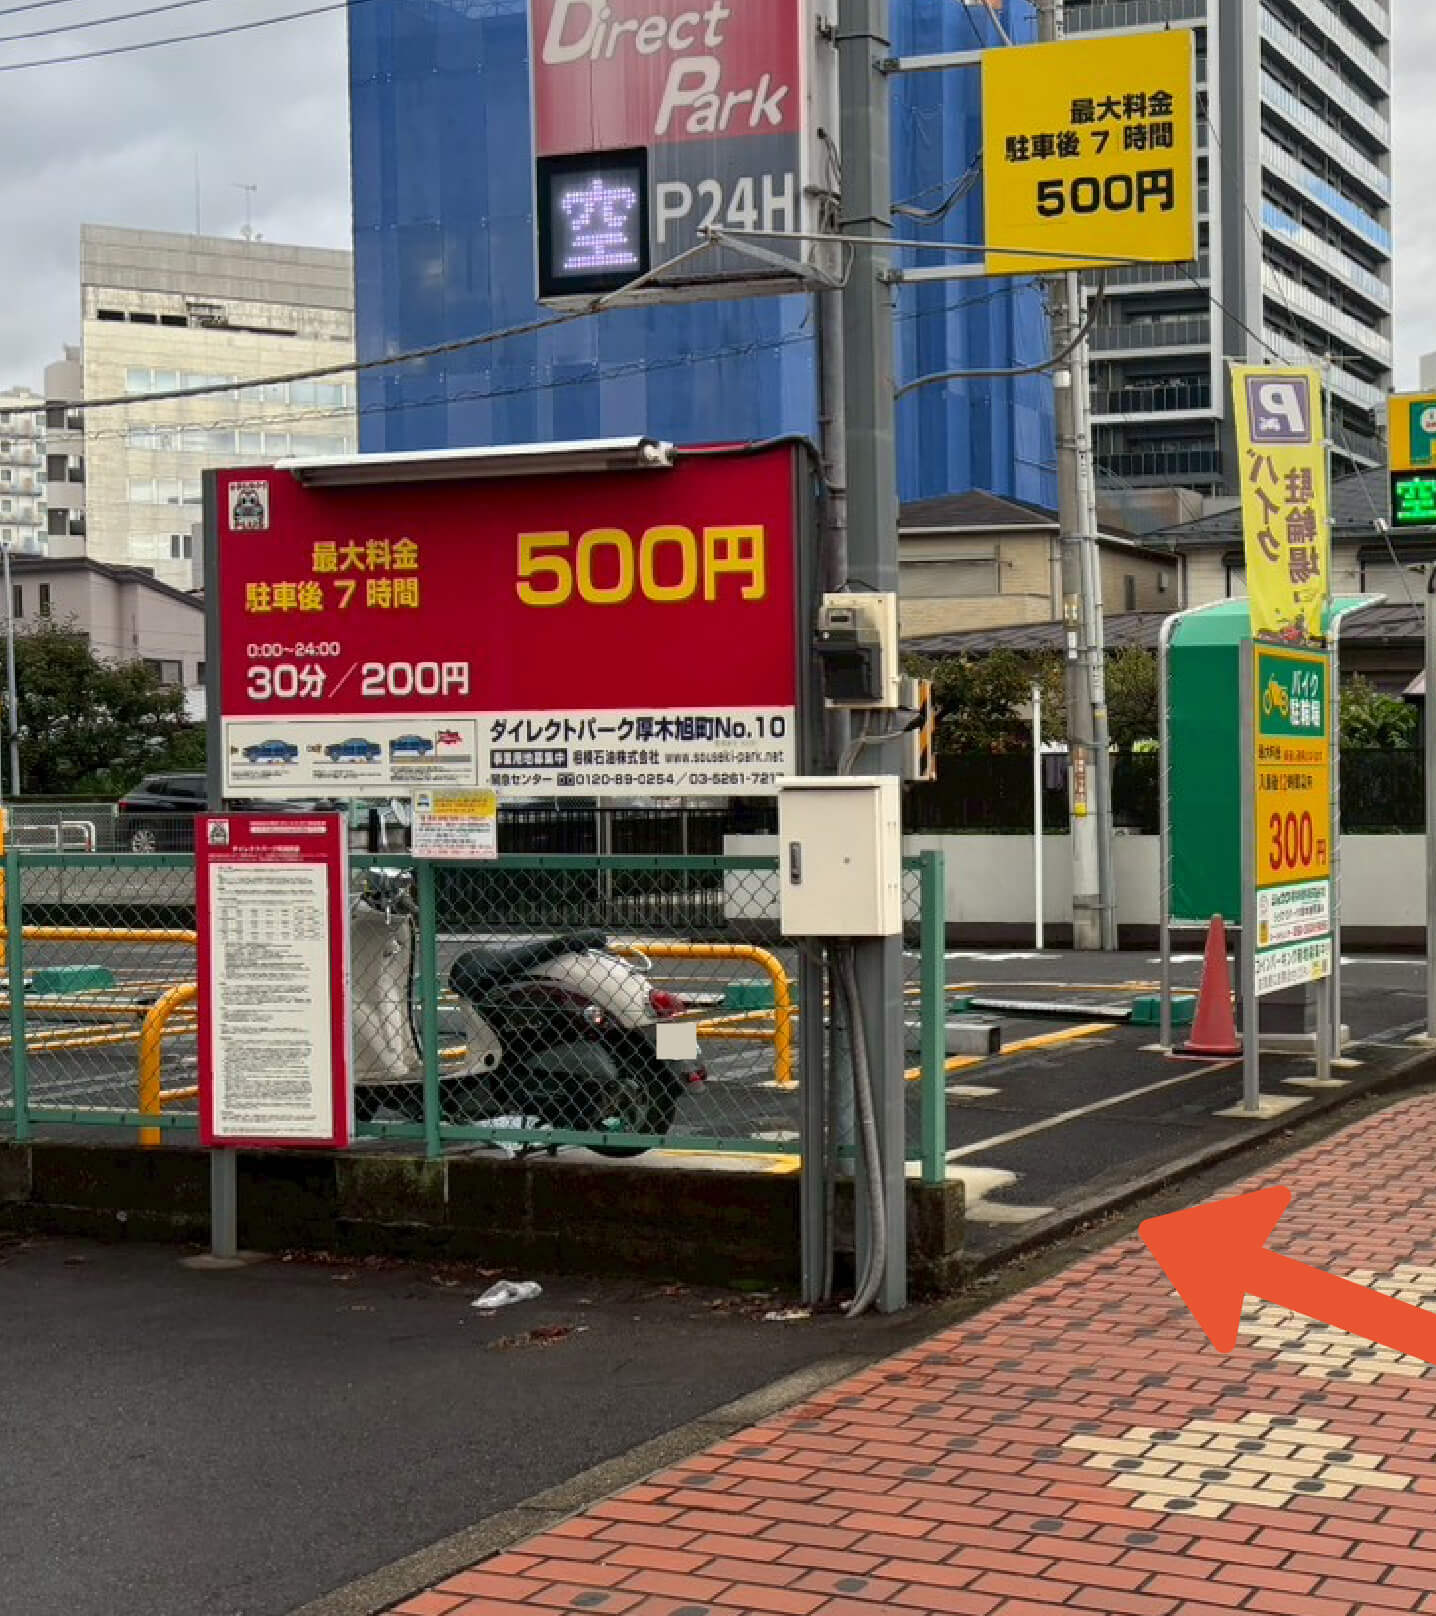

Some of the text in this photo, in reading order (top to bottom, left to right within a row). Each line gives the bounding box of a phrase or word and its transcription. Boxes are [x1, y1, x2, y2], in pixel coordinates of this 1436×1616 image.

[542, 0, 729, 64] Direct
[654, 54, 789, 135] Park
[1069, 90, 1173, 124] 最大料金
[1036, 168, 1174, 218] 500円
[561, 179, 638, 268] 空
[311, 537, 419, 573] 最大料金
[515, 523, 766, 607] 500円
[489, 715, 786, 743] ダイレクトパーク厚木旭町No.10
